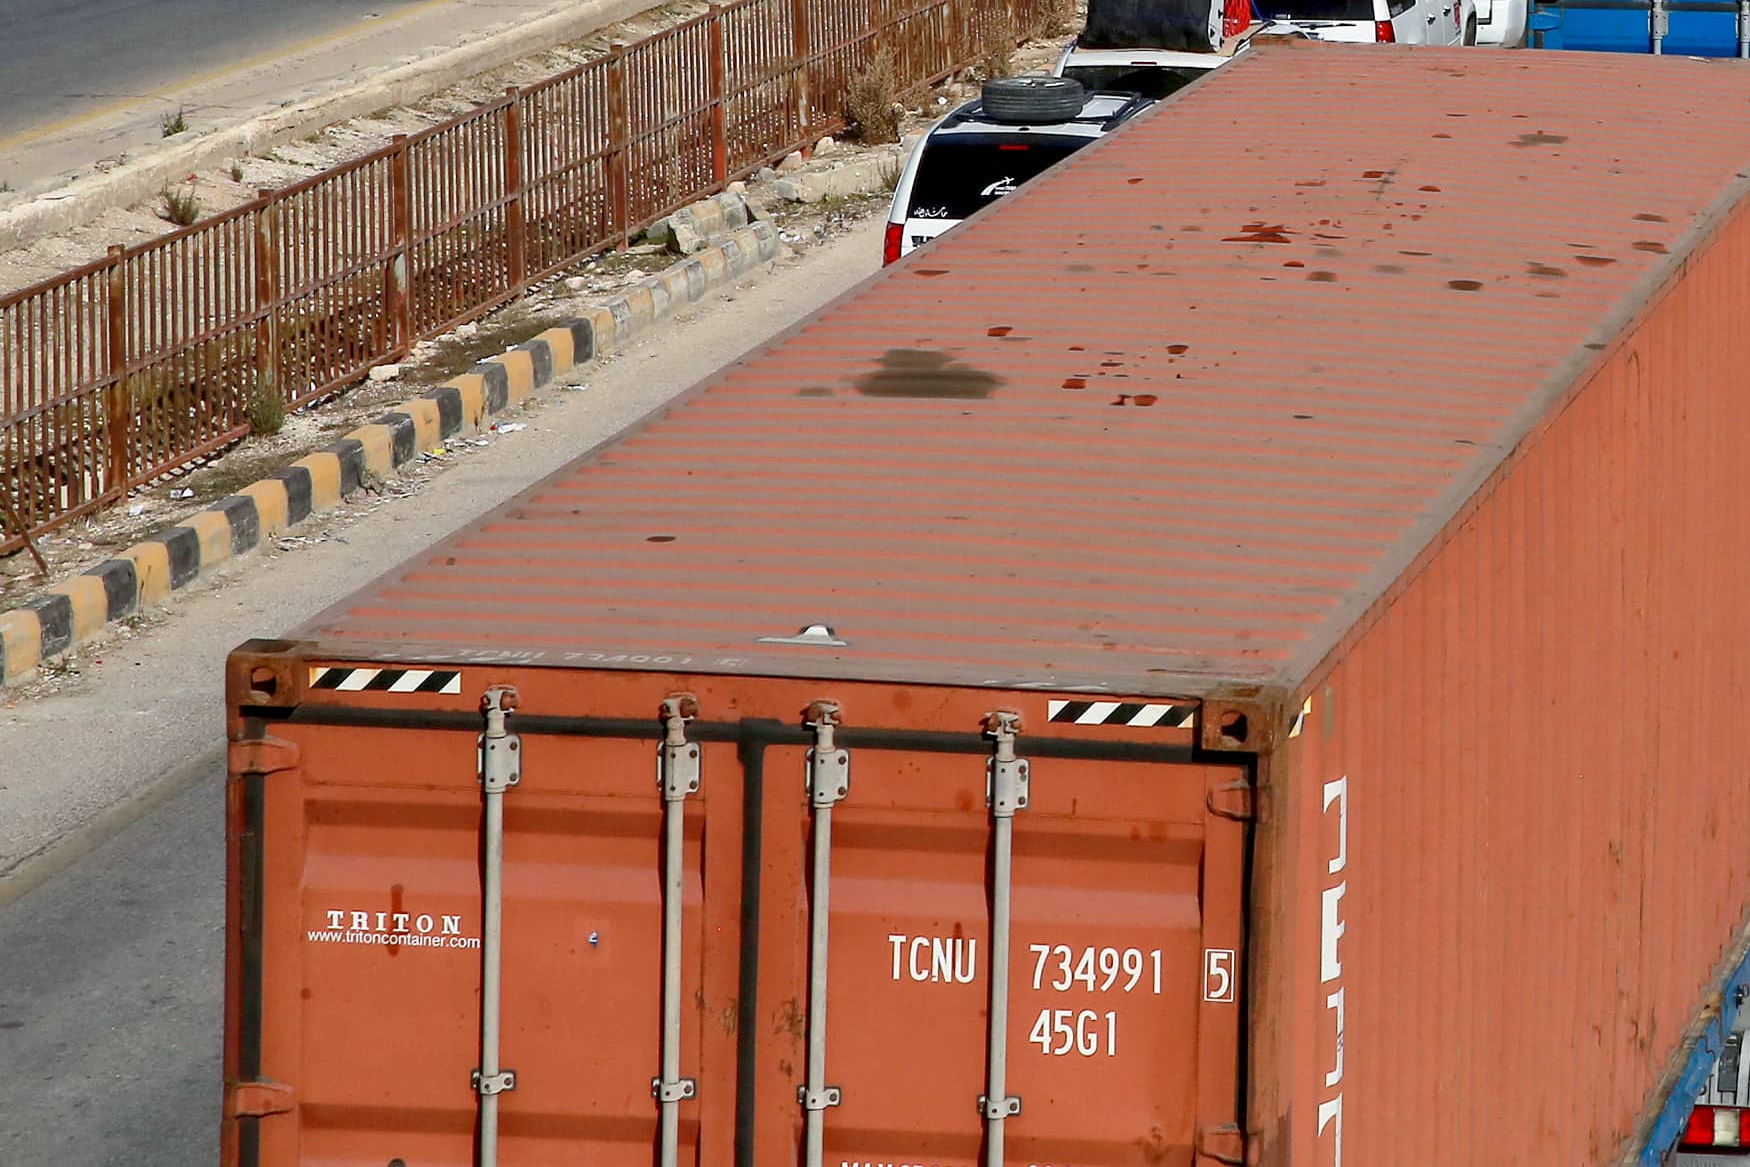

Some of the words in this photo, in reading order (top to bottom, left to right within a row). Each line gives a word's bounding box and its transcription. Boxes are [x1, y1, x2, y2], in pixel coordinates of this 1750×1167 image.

[307, 929, 482, 950] www.tritoncontainer.com
[326, 909, 462, 935] TRITON
[888, 934, 976, 983] TCNU
[1029, 944, 1163, 995] 734991
[1206, 951, 1232, 1000] 5
[1029, 1009, 1117, 1056] 45G1
